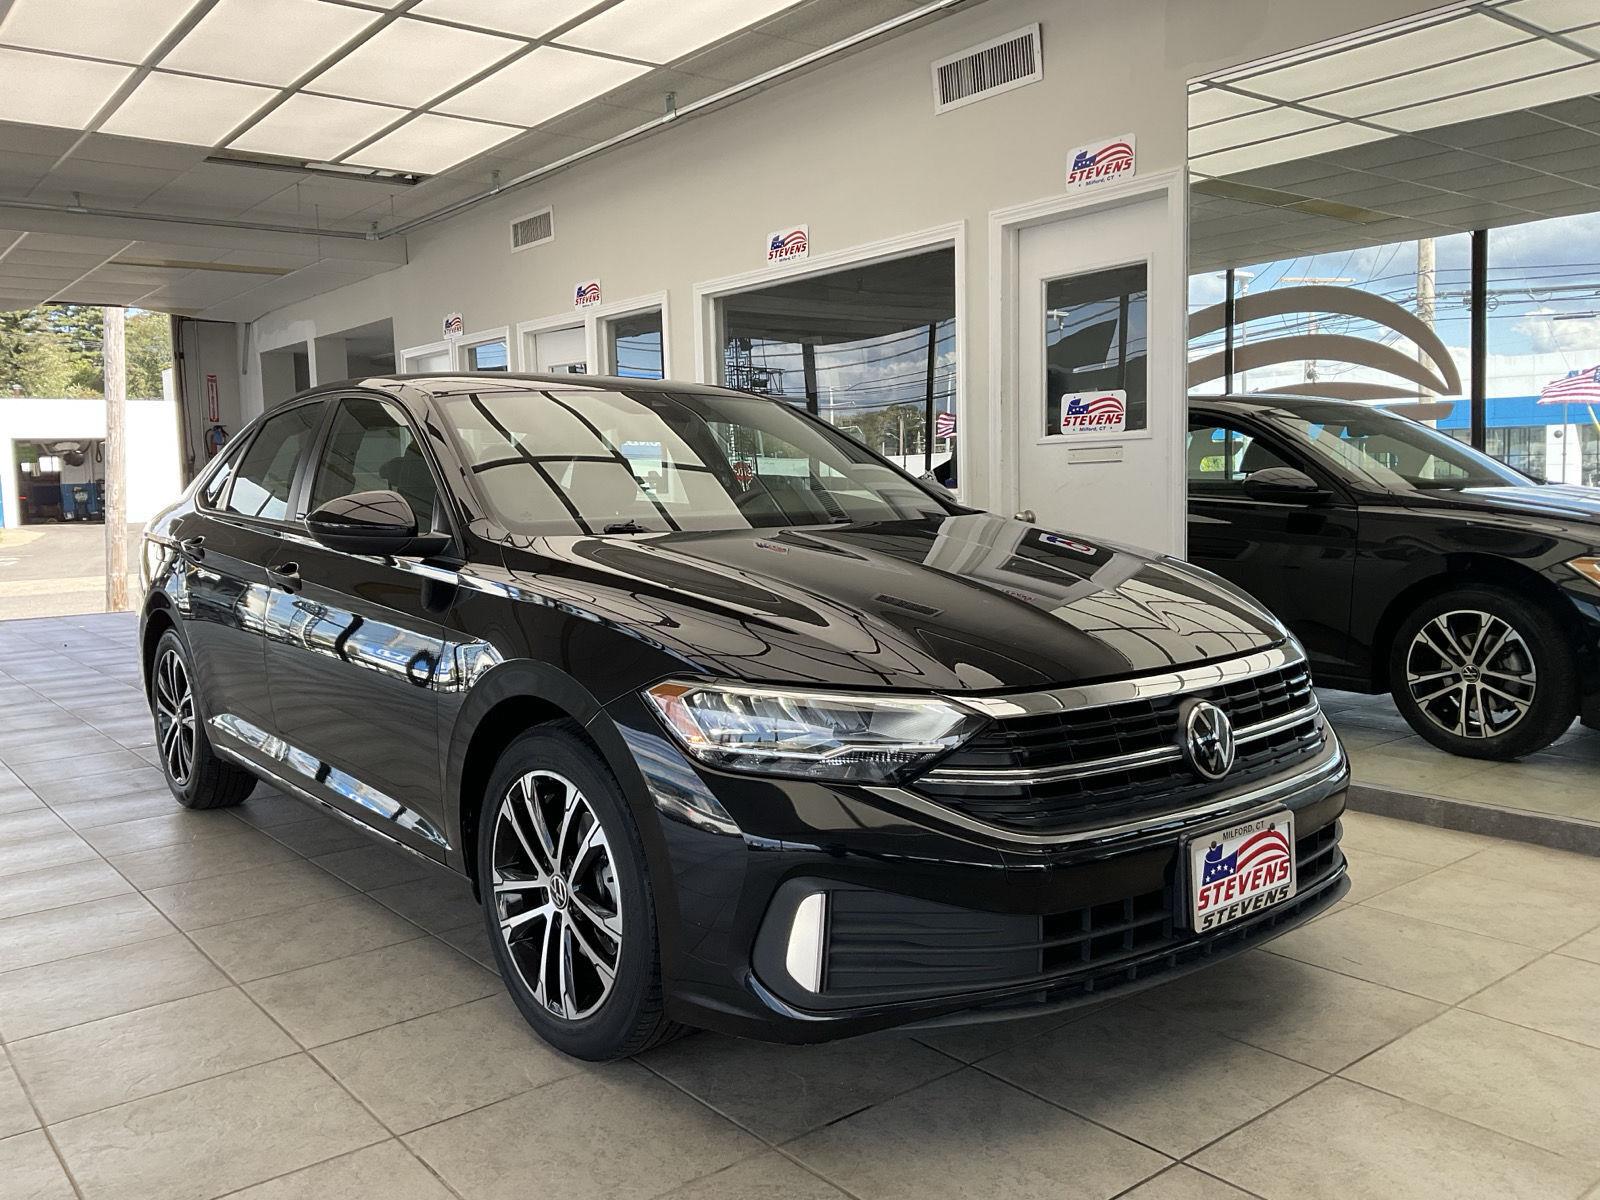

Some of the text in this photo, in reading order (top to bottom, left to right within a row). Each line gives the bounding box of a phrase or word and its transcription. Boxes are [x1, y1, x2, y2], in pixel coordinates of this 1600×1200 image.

[1067, 157, 1133, 184] STEVENS
[767, 242, 807, 260] STEVENS
[575, 293, 600, 305] STEVENS
[1062, 413, 1124, 427] STEVENS
[1222, 820, 1265, 840] MILFORD, CT
[1197, 857, 1290, 911] STEVENS
[1202, 884, 1290, 931] STEVENS
